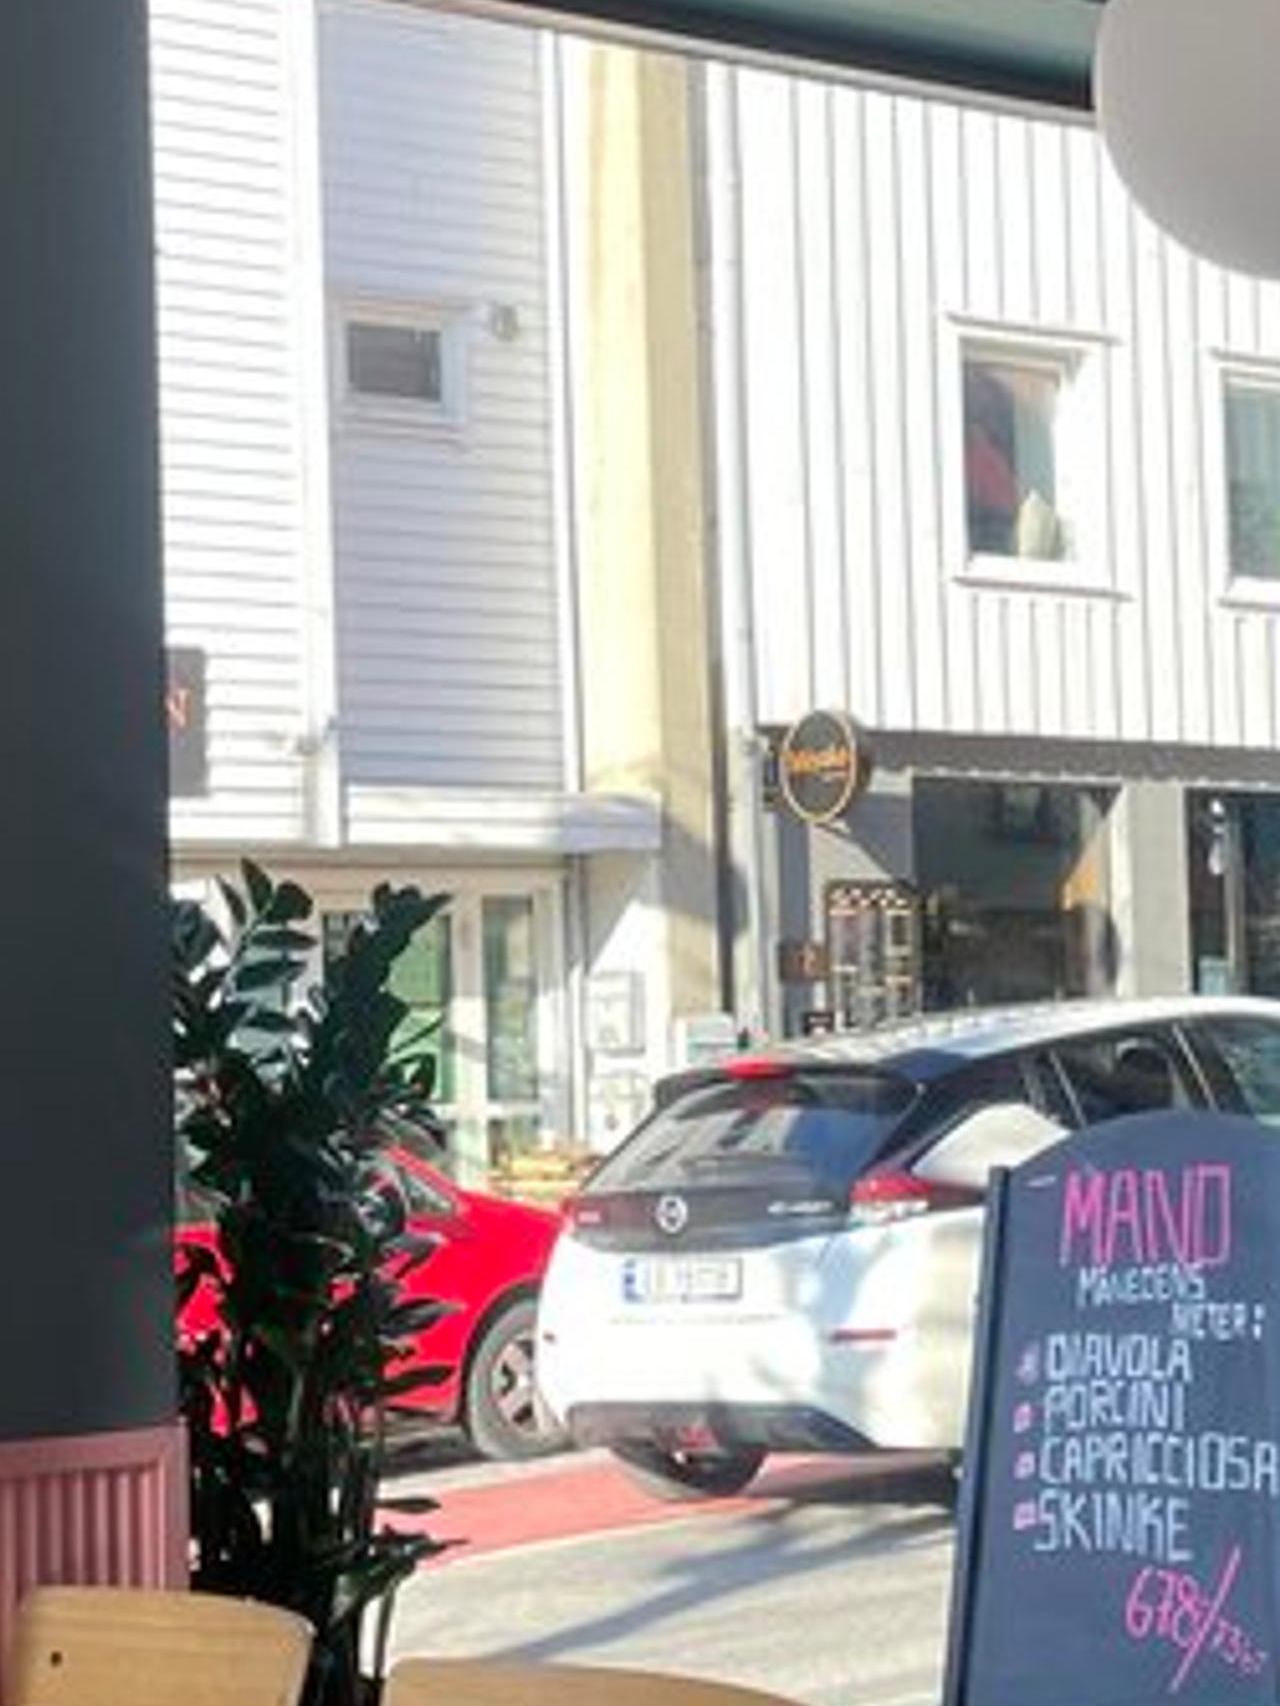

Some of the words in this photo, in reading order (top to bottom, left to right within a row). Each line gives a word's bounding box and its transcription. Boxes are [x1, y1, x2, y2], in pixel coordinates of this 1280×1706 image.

[1044, 1333, 1192, 1383] DIAVOLA
[1042, 1379, 1185, 1432] PORCINI
[1038, 1432, 1280, 1497] CAPRICCIOSA
[1034, 1489, 1194, 1562] SKINKE
